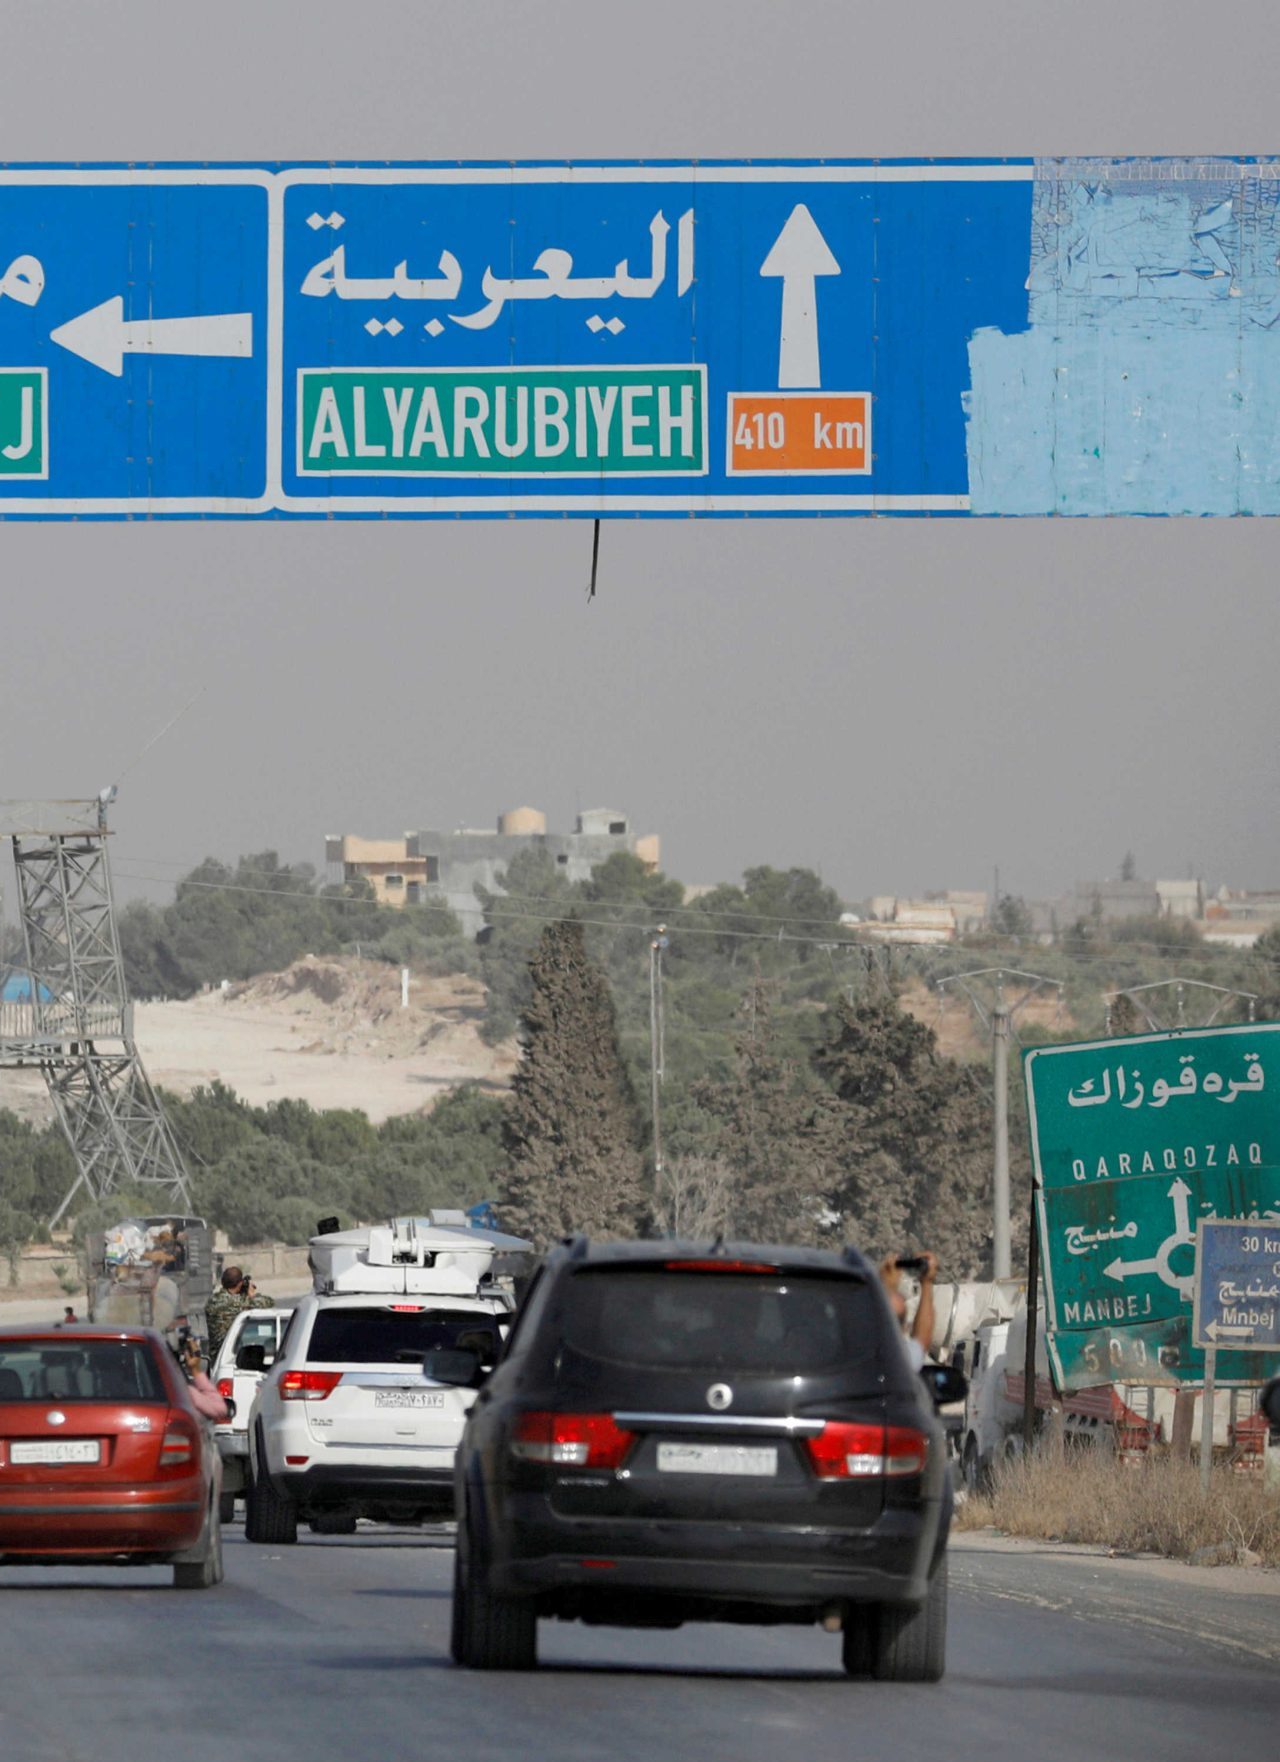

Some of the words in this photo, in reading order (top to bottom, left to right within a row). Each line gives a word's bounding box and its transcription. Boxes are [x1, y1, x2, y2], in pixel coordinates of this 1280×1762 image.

[300, 209, 694, 336] اليعربية
[308, 385, 693, 458] ALYARUBIYEH
[733, 412, 785, 452] 410
[813, 411, 864, 453] km
[1072, 1143, 1263, 1181] QARAQOZAQ
[1064, 1215, 1138, 1255] منبج
[1241, 1236, 1260, 1252] 30
[1063, 1293, 1152, 1323] MANBEJ
[1219, 1278, 1280, 1305] منبج
[1221, 1307, 1274, 1330] Mnbej
